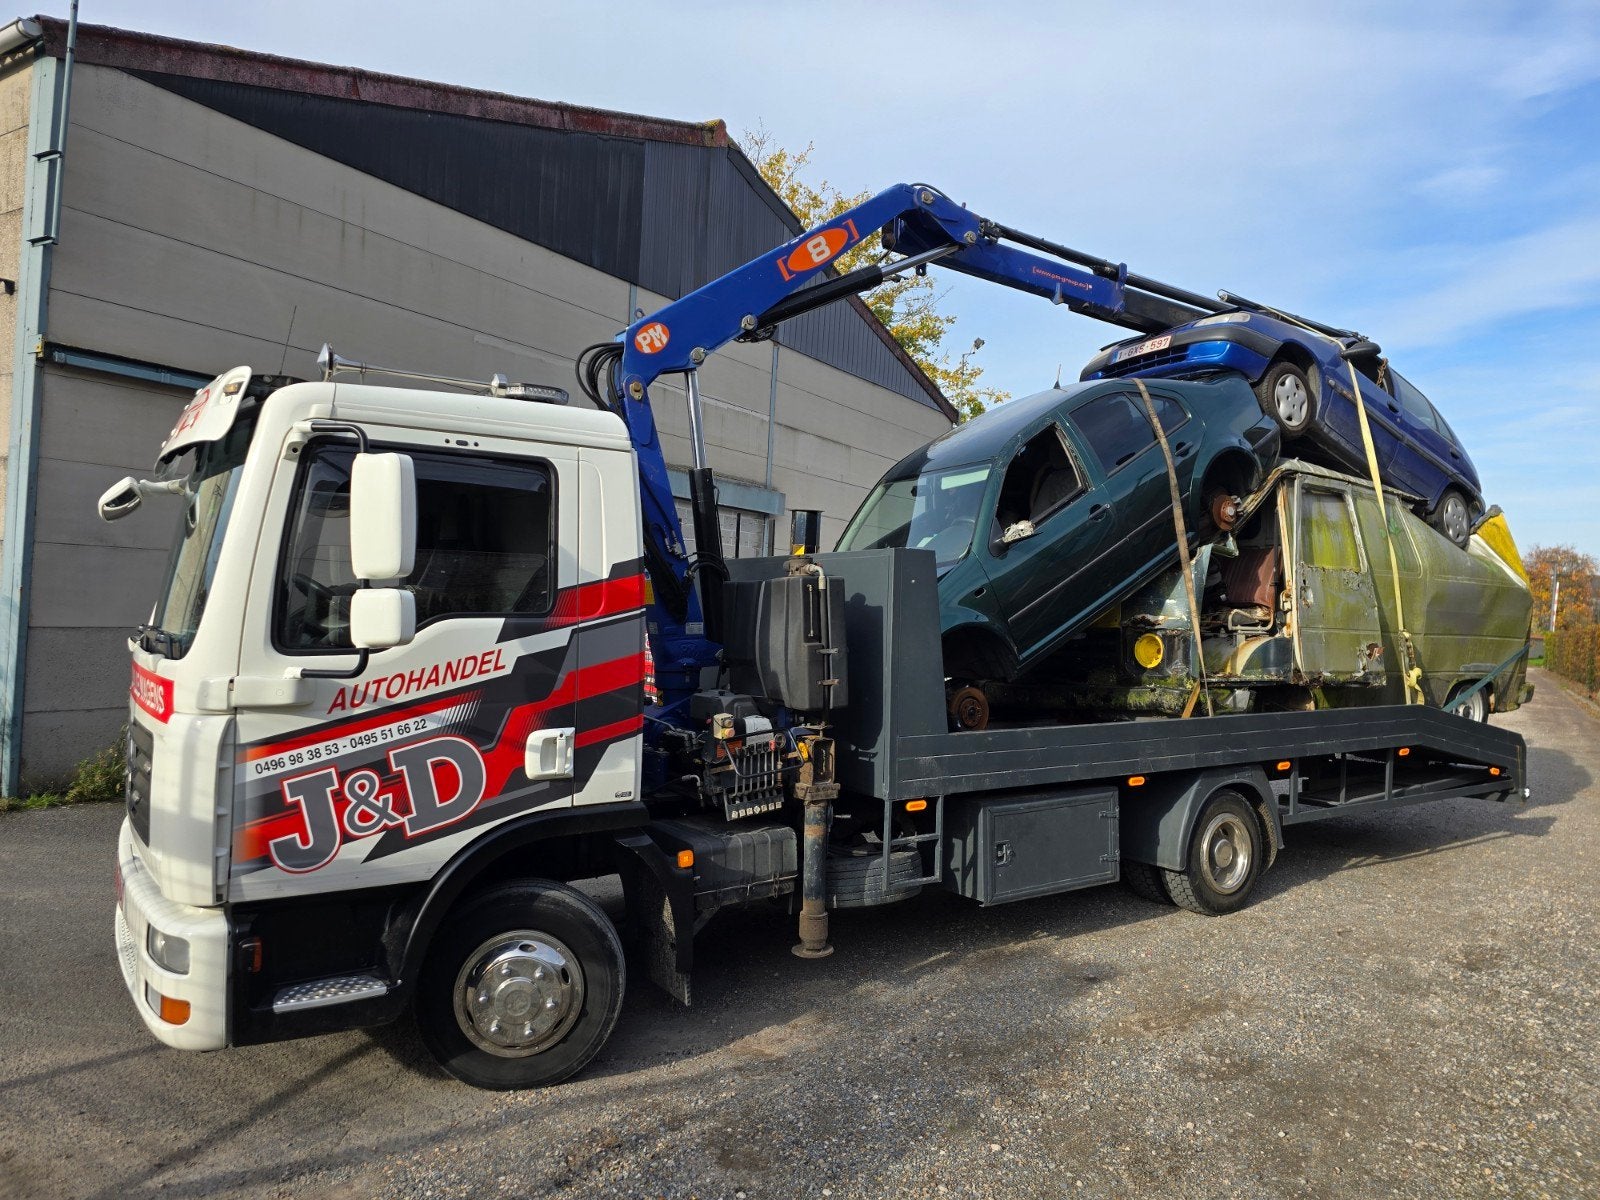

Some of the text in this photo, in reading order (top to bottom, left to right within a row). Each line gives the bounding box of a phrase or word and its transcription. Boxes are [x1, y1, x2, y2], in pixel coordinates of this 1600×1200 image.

[636, 323, 669, 354] PM
[327, 648, 507, 715] AUTOHANDEL
[255, 757, 286, 775] 0496
[289, 752, 304, 765] 98
[307, 747, 322, 761] 38
[324, 742, 340, 756] 53
[349, 732, 378, 749] 0495
[380, 727, 394, 741] 51
[396, 722, 411, 736] 66
[413, 718, 428, 731] 22
[269, 736, 488, 874] J&D
